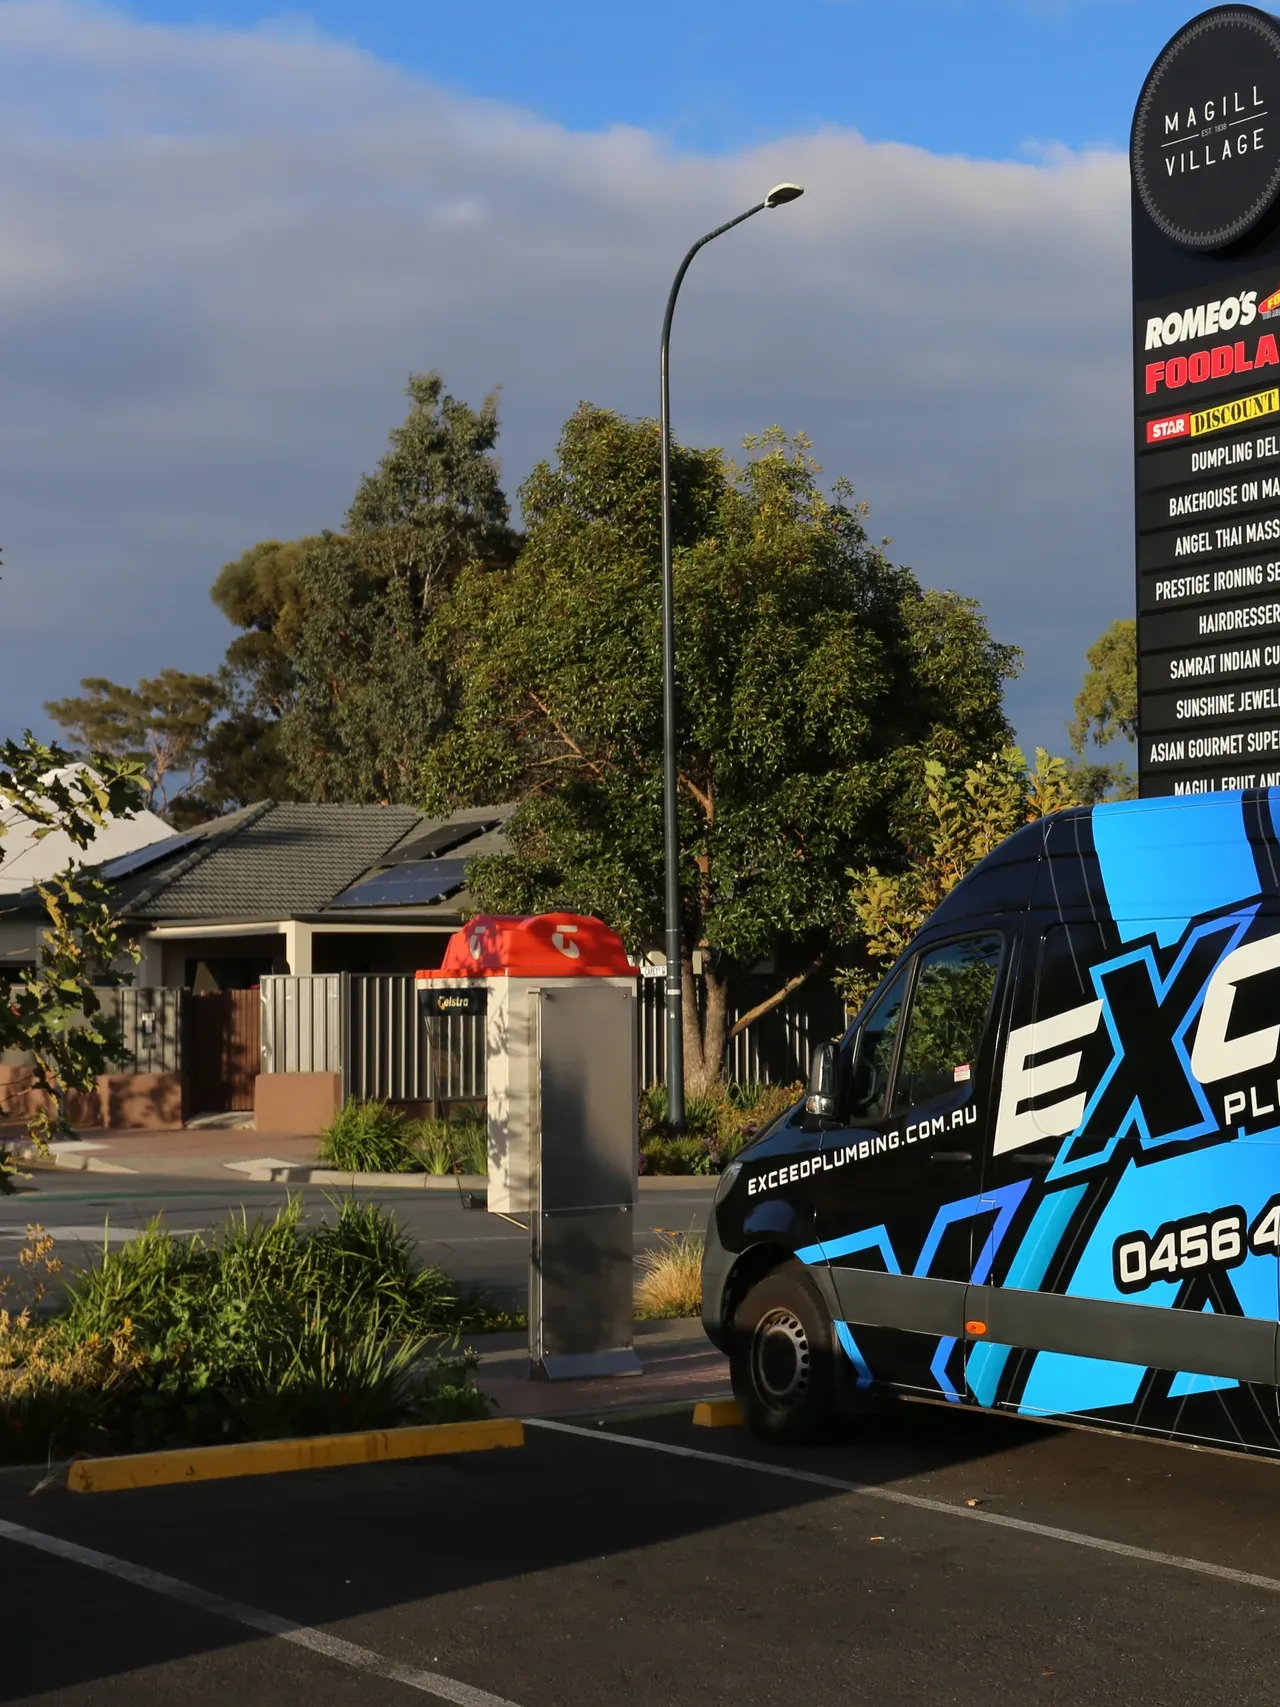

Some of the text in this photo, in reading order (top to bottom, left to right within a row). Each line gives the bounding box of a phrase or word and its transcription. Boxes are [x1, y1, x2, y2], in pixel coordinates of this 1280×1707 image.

[1164, 85, 1264, 134] MAGILL
[1165, 128, 1264, 176] VILLAGE
[1145, 290, 1258, 350] ROMEO'S
[1152, 419, 1185, 438] STAR
[1194, 390, 1276, 434] DISCOUNT
[1191, 441, 1253, 472] DUMPLING
[1169, 485, 1238, 517] BAKEHOUSE
[1241, 482, 1258, 503] ON
[1175, 531, 1212, 556] ANGEL
[1216, 526, 1242, 549] THAI
[1155, 574, 1210, 601] PRESTIGE
[1214, 565, 1263, 592] IRONING
[1199, 603, 1280, 635] HAIRDRESSER
[1170, 655, 1216, 680] SAMRAT
[1220, 648, 1260, 672] INDIAN
[1176, 694, 1235, 720] SUNSHINE
[1150, 741, 1185, 763] ASIAN
[1188, 734, 1244, 759] GOURMET
[437, 995, 469, 1010] Telstra
[748, 1105, 977, 1195] EXCEEDPLUMBING.COM.AU
[1120, 1217, 1240, 1285] 0456
